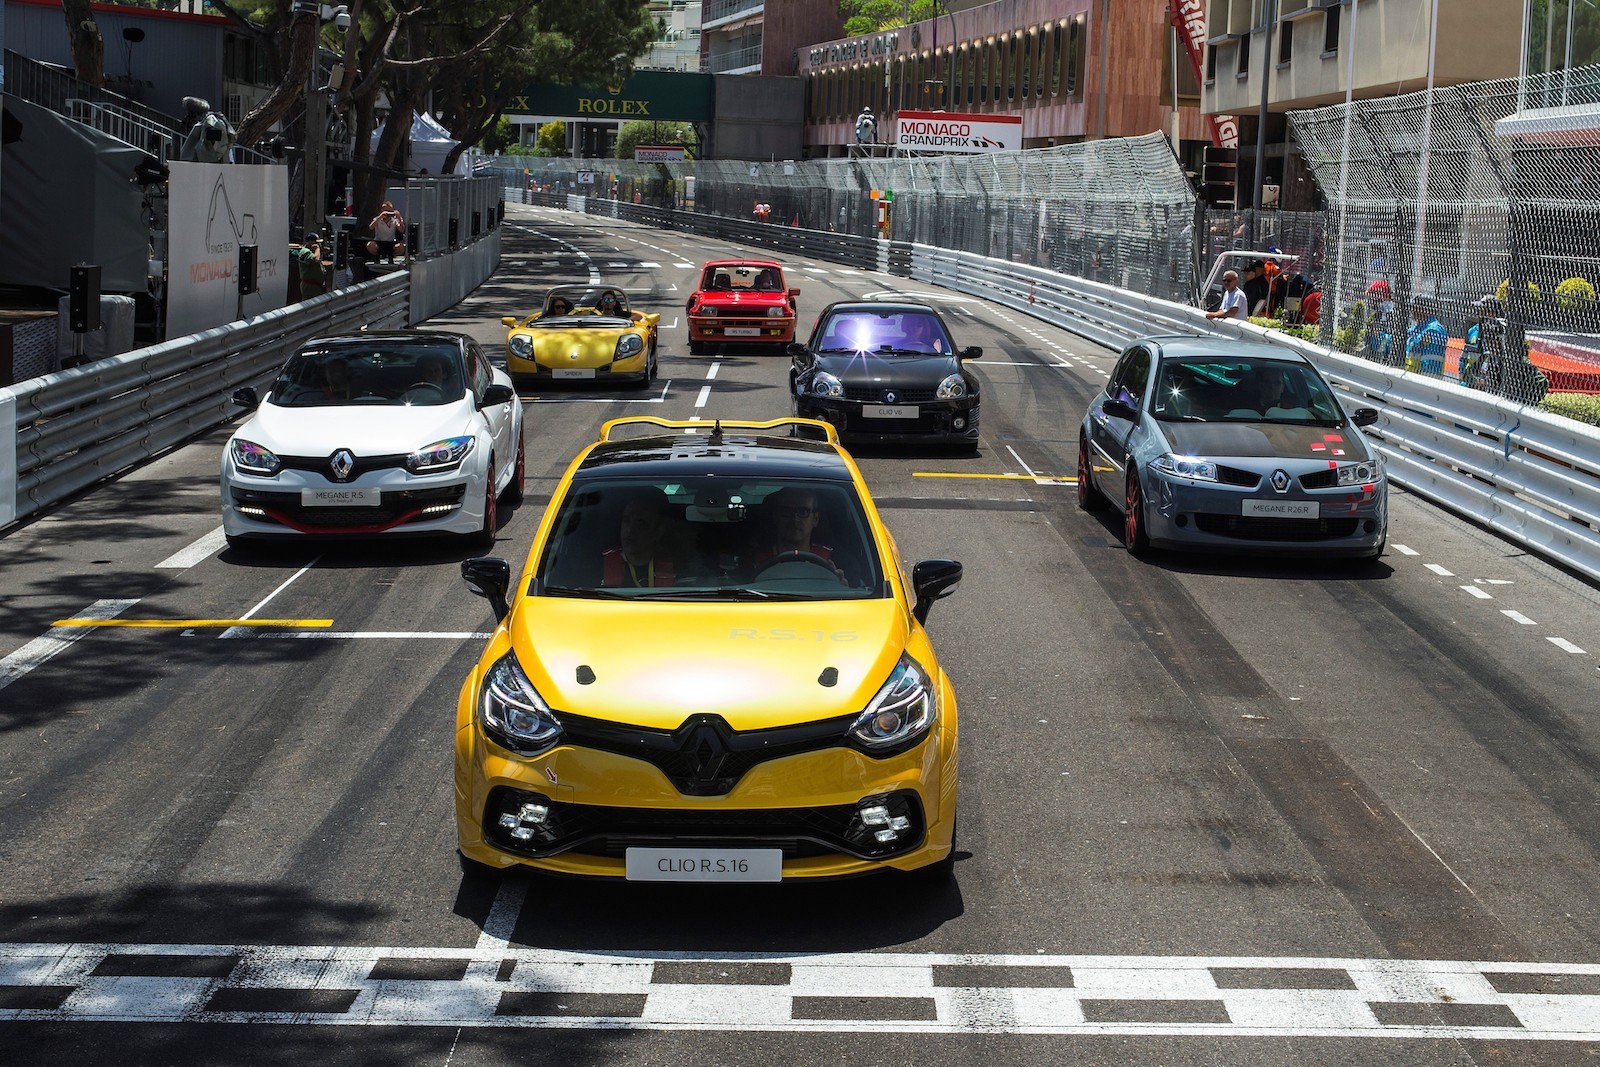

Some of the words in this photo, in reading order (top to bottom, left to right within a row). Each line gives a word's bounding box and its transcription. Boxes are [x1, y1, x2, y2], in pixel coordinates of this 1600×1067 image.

[578, 98, 650, 115] ROLEX
[901, 121, 970, 136] MONACO
[900, 134, 970, 147] GRANDPRIX
[211, 245, 223, 254] SINCE
[190, 259, 233, 284] MONACO
[1253, 504, 1286, 513] MEGANE
[1287, 506, 1309, 514] R26.R
[729, 627, 859, 642] R.S.16
[657, 858, 696, 872] CLIO
[701, 859, 749, 873] R.S.16
